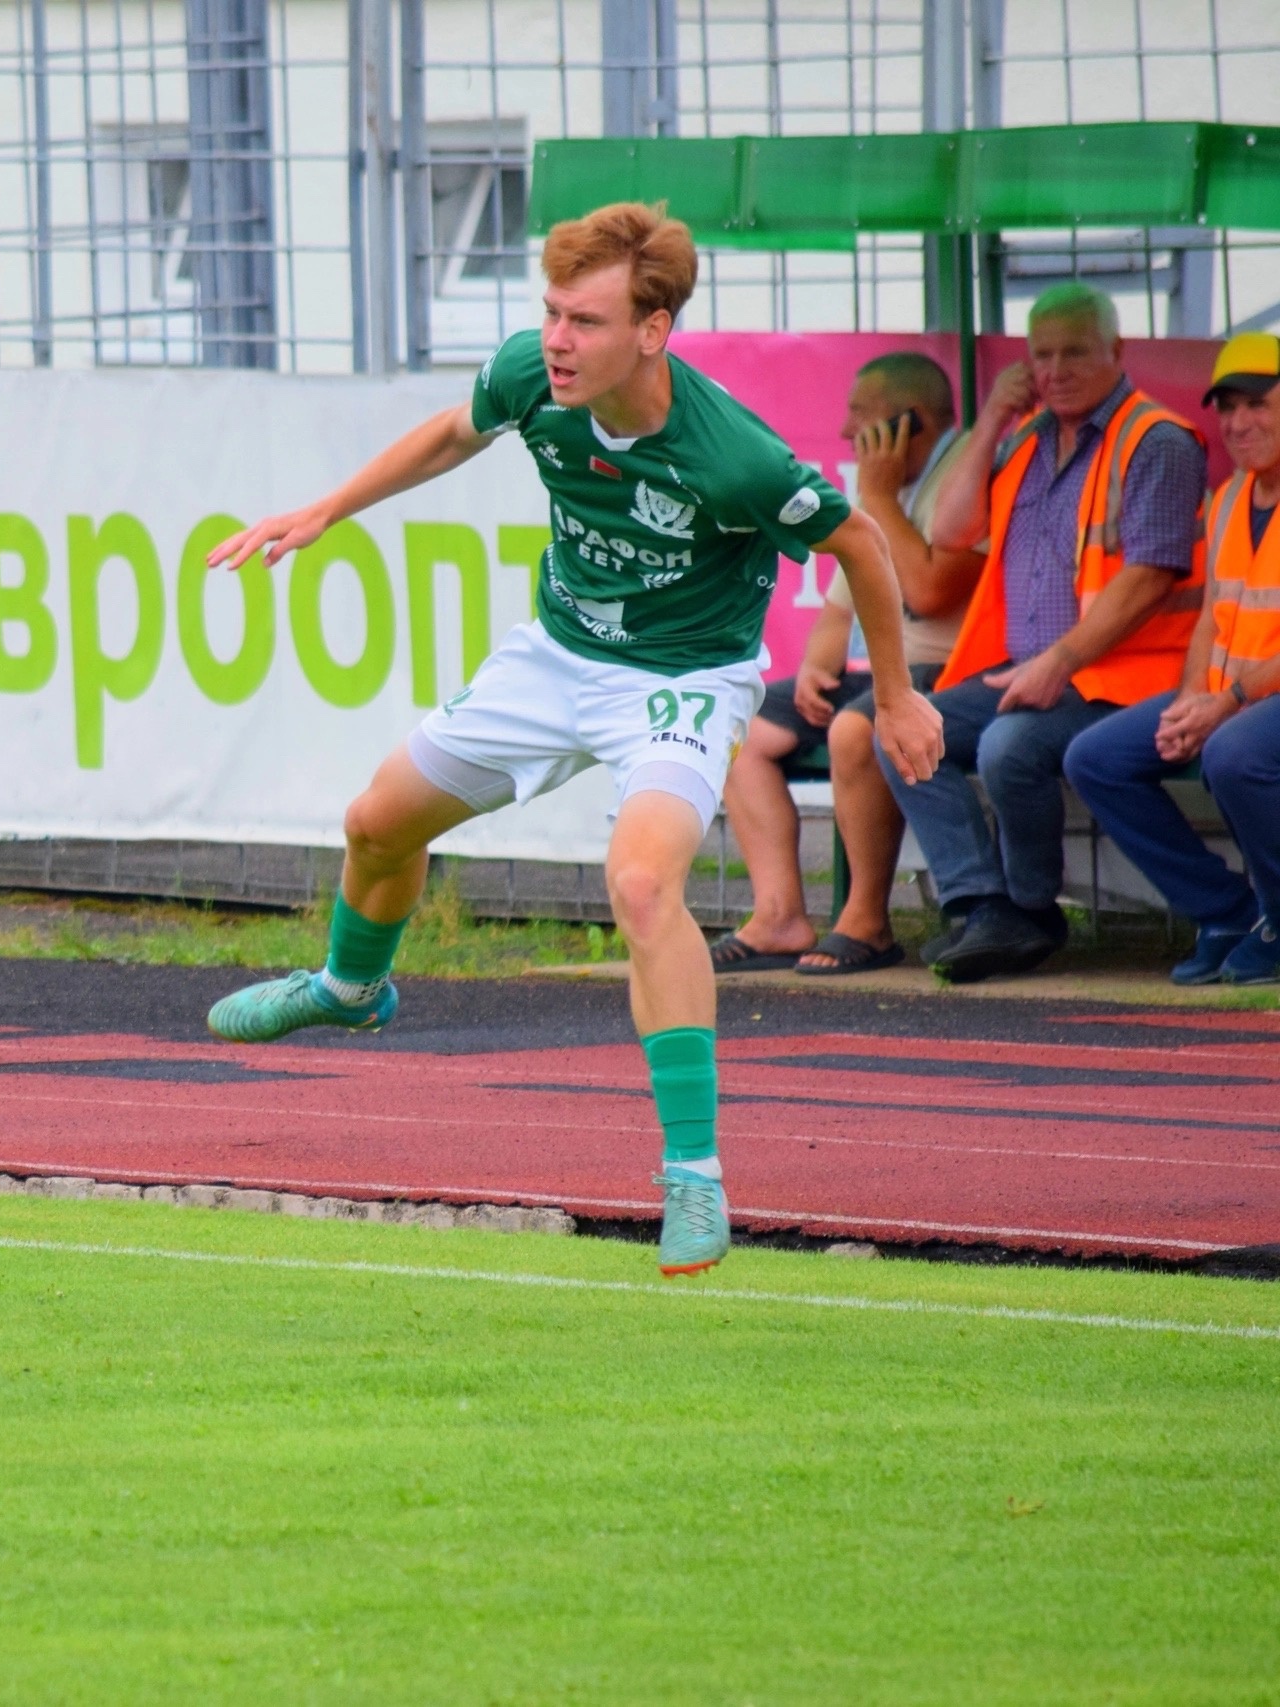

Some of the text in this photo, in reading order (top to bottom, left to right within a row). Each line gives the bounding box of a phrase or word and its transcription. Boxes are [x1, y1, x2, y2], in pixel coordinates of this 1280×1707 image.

[578, 542, 624, 572] БЕТ
[647, 688, 716, 736] 97
[650, 731, 707, 756] KELME
